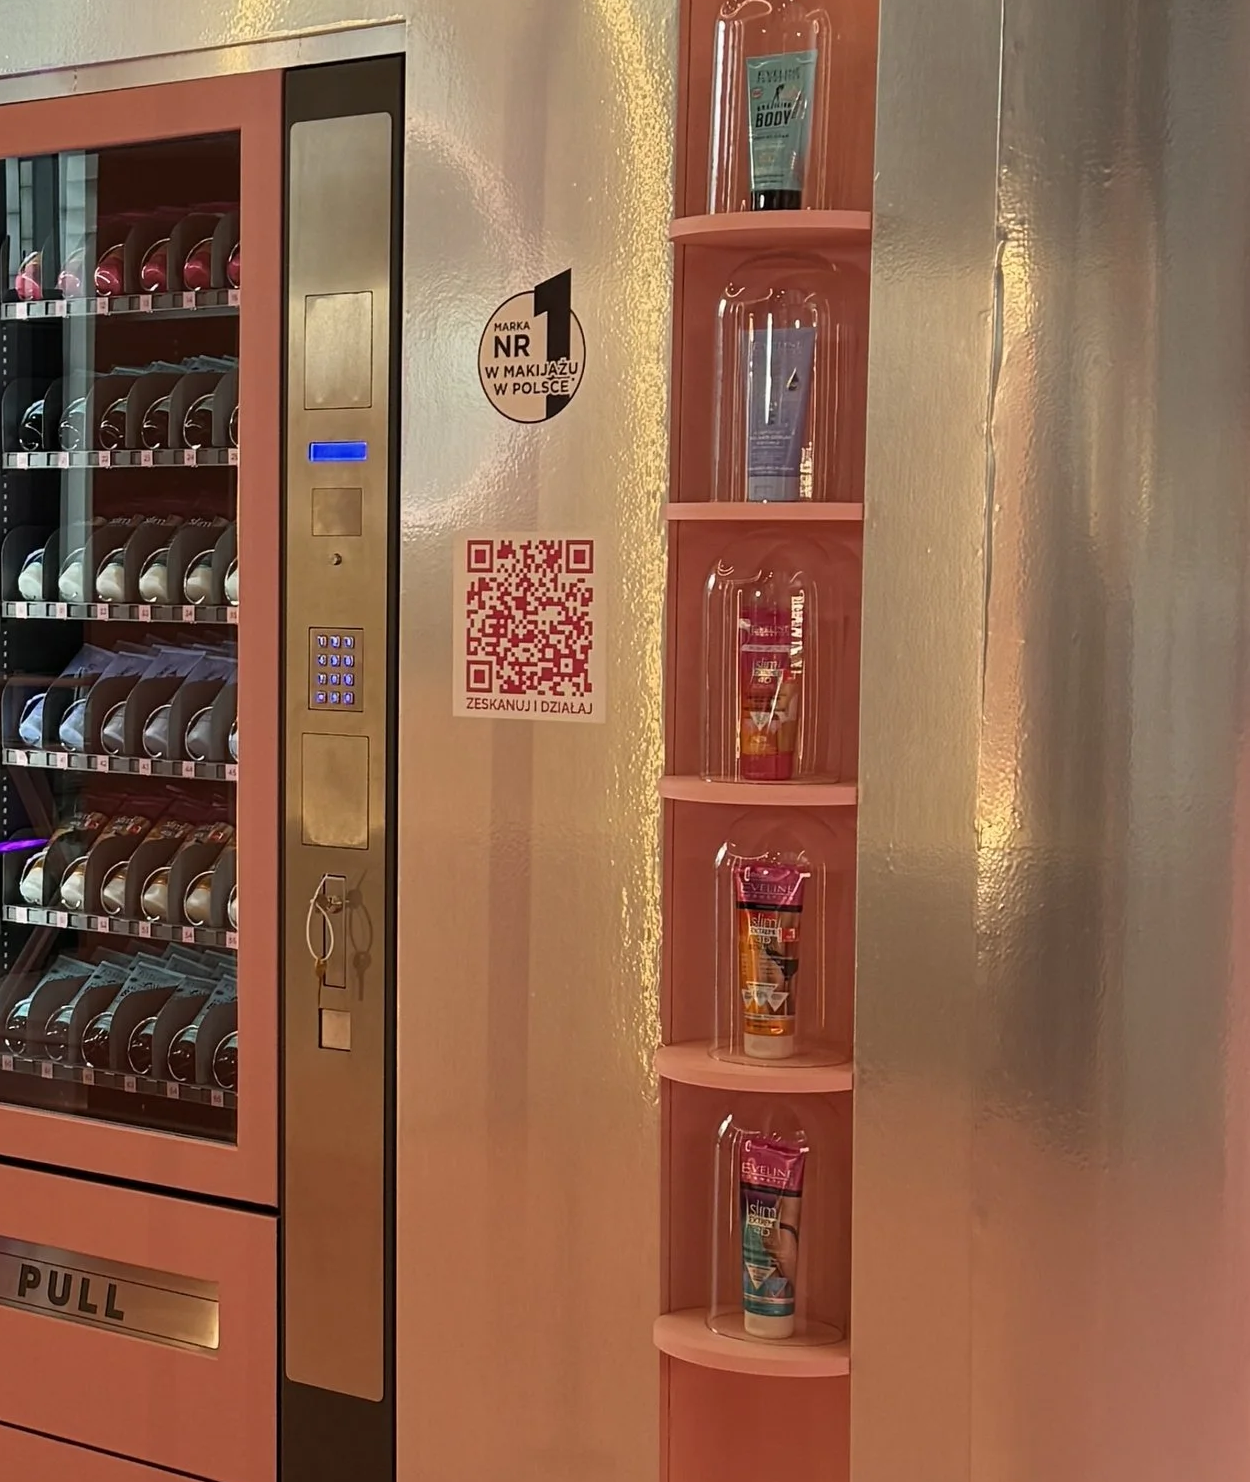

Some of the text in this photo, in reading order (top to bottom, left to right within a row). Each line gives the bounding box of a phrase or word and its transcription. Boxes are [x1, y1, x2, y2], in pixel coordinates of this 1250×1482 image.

[755, 109, 792, 128] BODY
[493, 321, 531, 332] MARKA
[493, 267, 572, 419] NR 1
[484, 357, 579, 379] W MAKIJAŻU
[493, 380, 570, 396] W POLSCE
[466, 697, 593, 715] ZESKANUJ I DZIAŁAJ
[750, 912, 778, 928] slim
[749, 1200, 778, 1219] slim
[17, 1263, 125, 1321] PULL
